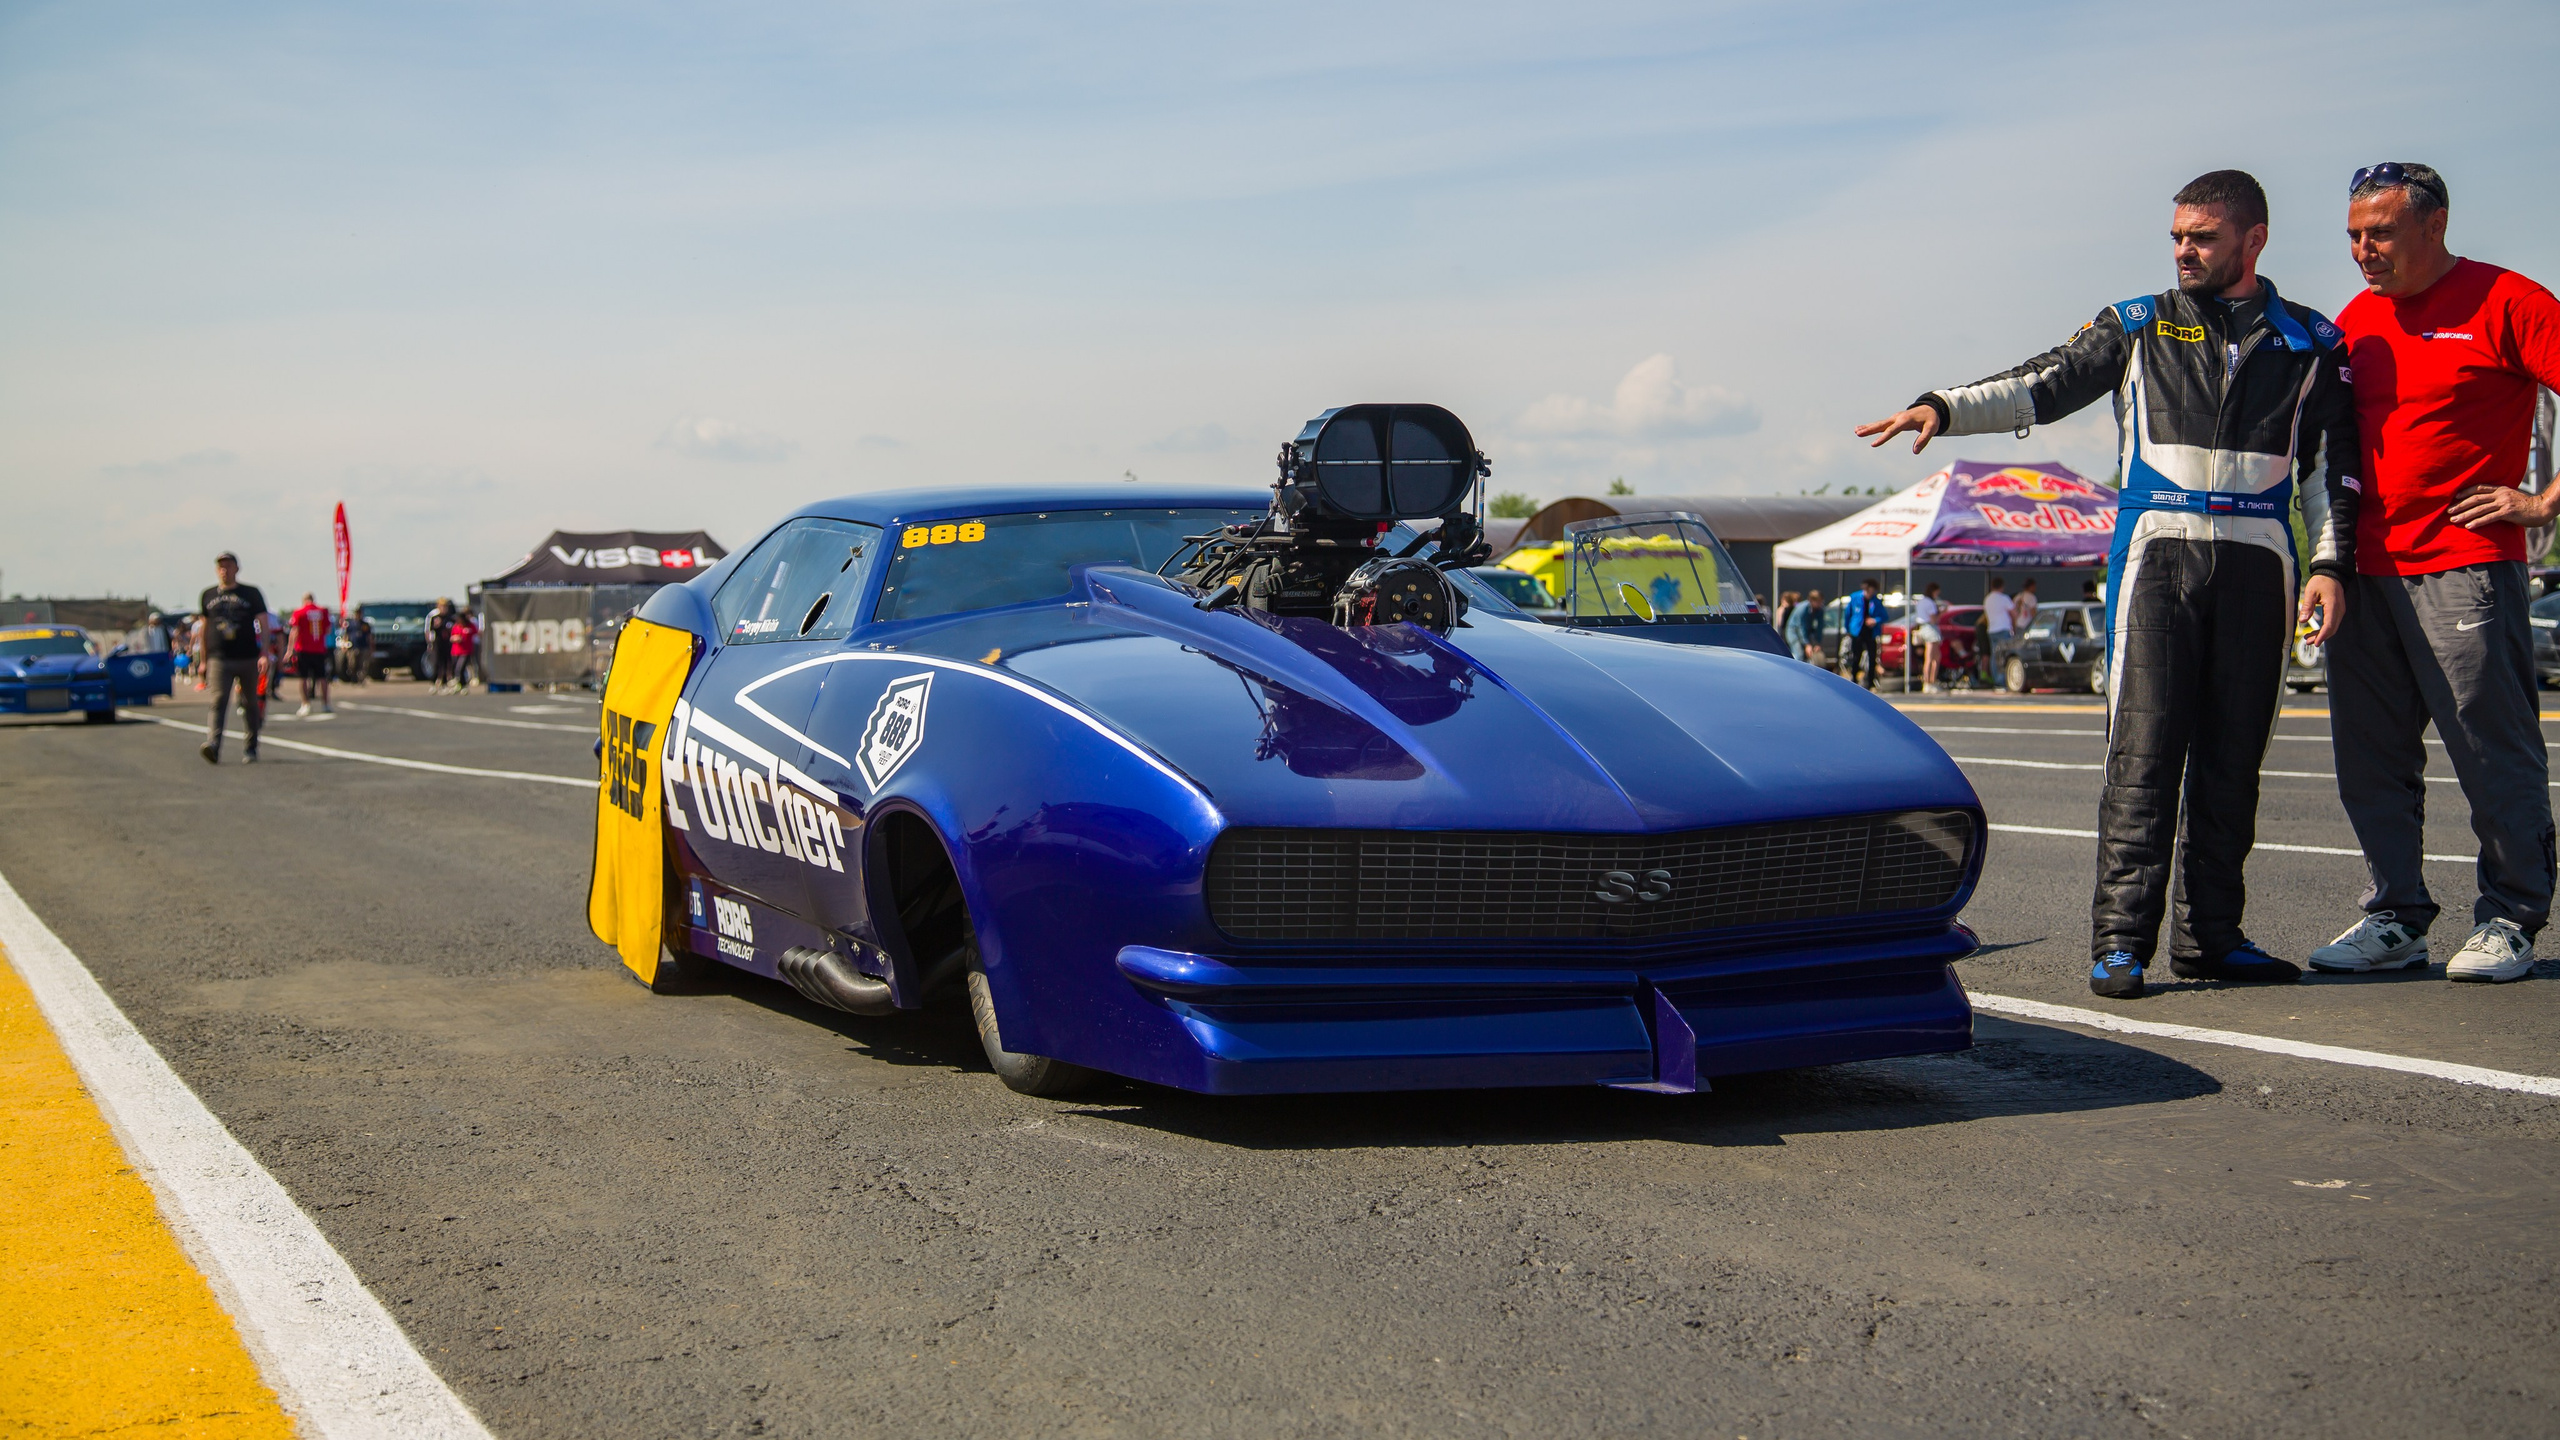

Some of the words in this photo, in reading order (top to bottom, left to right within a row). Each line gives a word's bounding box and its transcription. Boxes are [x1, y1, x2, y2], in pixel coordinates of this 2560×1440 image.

[1976, 502, 2059, 531] Red
[2056, 504, 2118, 534] Bul
[902, 523, 986, 549] 888
[879, 711, 912, 752] 888
[661, 697, 845, 873] Puncher
[1595, 869, 1672, 902] SS
[717, 937, 755, 962] TECHNOLOGY
